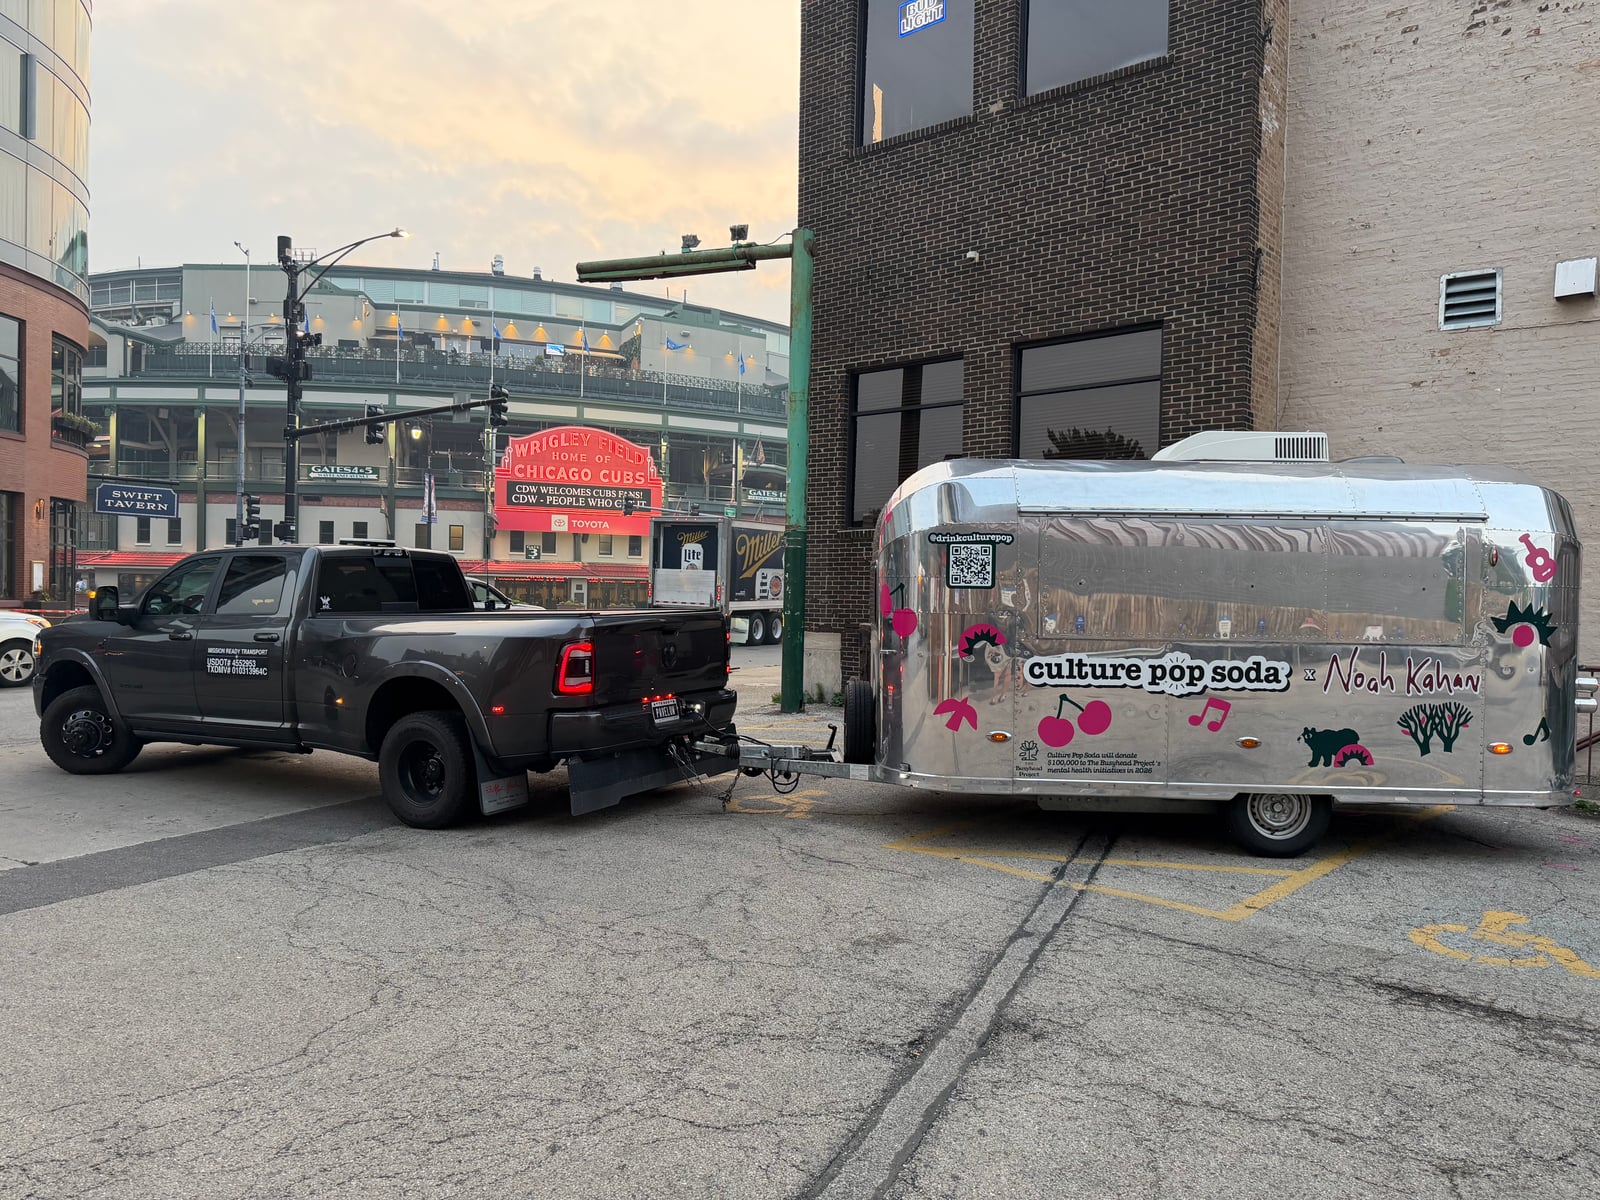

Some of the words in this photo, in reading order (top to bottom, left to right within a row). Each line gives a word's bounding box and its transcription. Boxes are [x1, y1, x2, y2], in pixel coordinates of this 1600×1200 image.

[906, 0, 937, 18] BUD
[901, 4, 943, 34] LIGHT
[514, 432, 591, 458] WRIGLEY
[598, 435, 645, 465] FIELD
[552, 451, 587, 462] HOME
[595, 454, 611, 463] OF
[311, 465, 351, 473] GATES
[514, 463, 592, 481] CHICAGO
[599, 469, 645, 485] CUBS
[112, 490, 163, 501] SWIFT
[515, 484, 538, 493] CDW
[540, 486, 591, 496] WELCOMES
[593, 488, 617, 498] CUBS
[748, 489, 778, 498] GATES
[104, 499, 168, 511] TAVERN
[511, 494, 538, 503] CDW
[546, 496, 586, 506] PEOPLE
[588, 498, 613, 508] WHO
[571, 519, 610, 529] TOYOTA
[677, 530, 709, 546] Miller
[930, 534, 1012, 543] @drinkculturepop
[528, 548, 538, 557] 3
[684, 549, 701, 563] Lite
[736, 531, 784, 571] Miller
[207, 658, 231, 666] USDOT#
[207, 665, 231, 674] TXDMV#
[1028, 658, 1142, 681] culture
[1148, 663, 1205, 687] pop
[1211, 661, 1282, 684] soda
[1323, 646, 1396, 694] Noah
[1406, 656, 1482, 695] Kahan
[1047, 759, 1079, 767] $100,000
